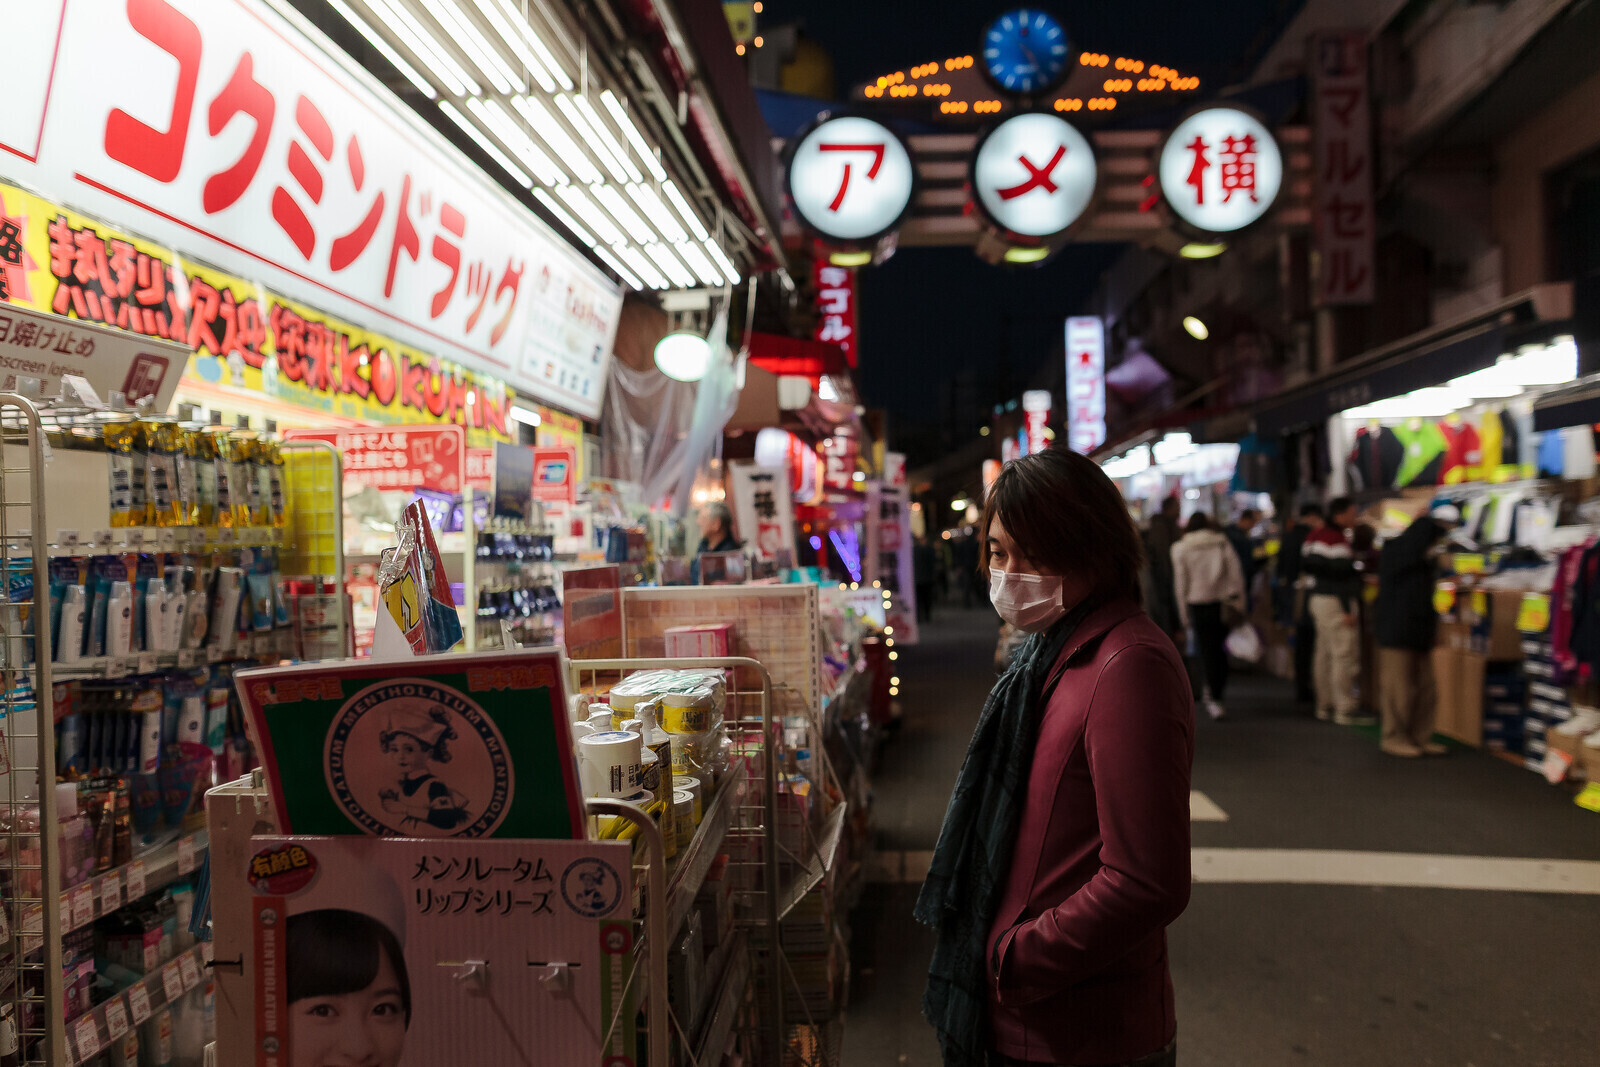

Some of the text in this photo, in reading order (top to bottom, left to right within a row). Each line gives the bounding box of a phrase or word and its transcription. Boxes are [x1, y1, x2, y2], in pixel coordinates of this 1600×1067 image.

[104, 0, 526, 347] コクミンドラッグ
[819, 133, 1259, 213] アメ横
[1321, 87, 1367, 294] マルセル
[0, 315, 95, 357] 日焼け止め
[344, 683, 482, 727] MENTHOLATUM
[411, 855, 554, 882] メンソレータム
[416, 887, 556, 915] リップシリーズ
